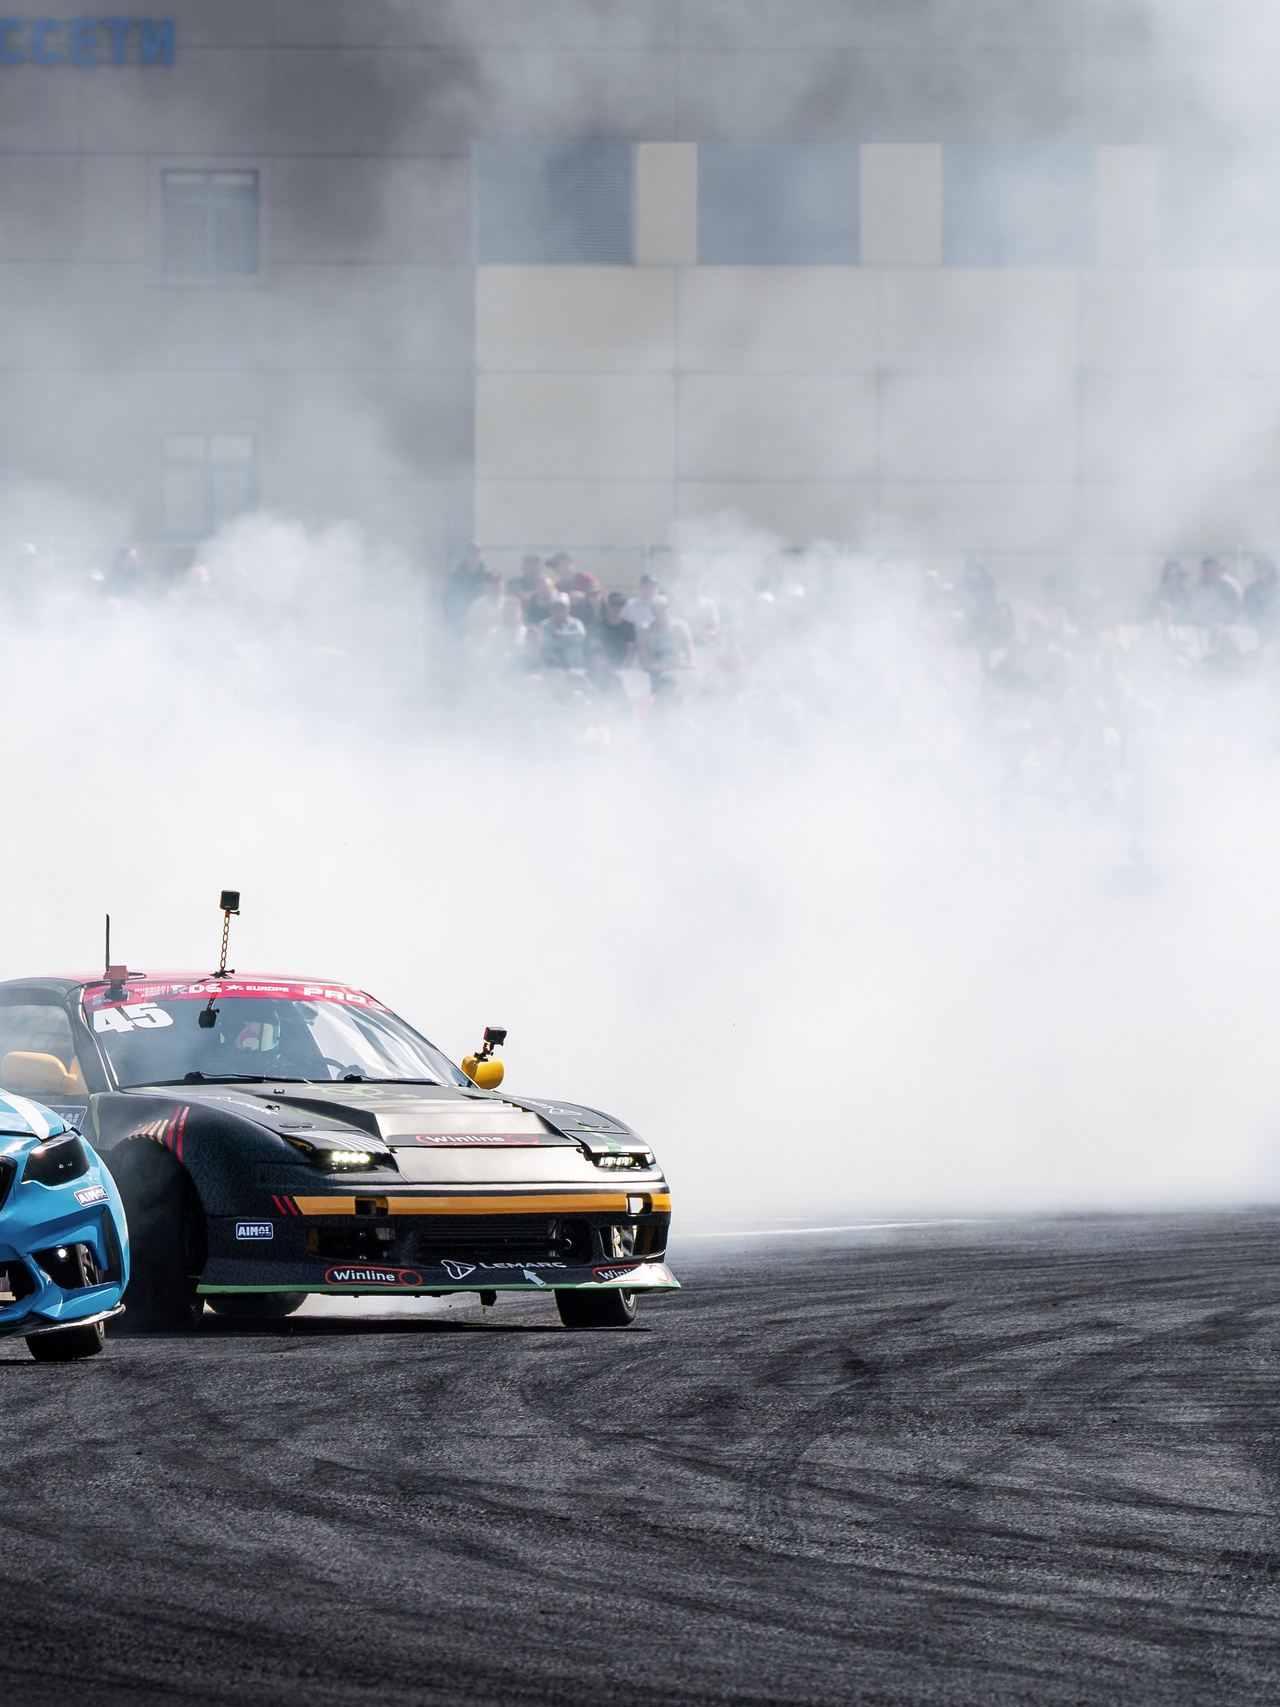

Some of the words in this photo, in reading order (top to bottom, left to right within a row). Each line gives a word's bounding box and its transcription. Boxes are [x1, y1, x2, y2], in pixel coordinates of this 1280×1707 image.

[170, 983, 223, 994] RDS
[303, 987, 367, 1004] PRO
[93, 1002, 174, 1033] 45
[425, 1135, 505, 1143] Winline
[238, 1226, 271, 1236] AIMOL
[334, 1270, 396, 1281] Winline
